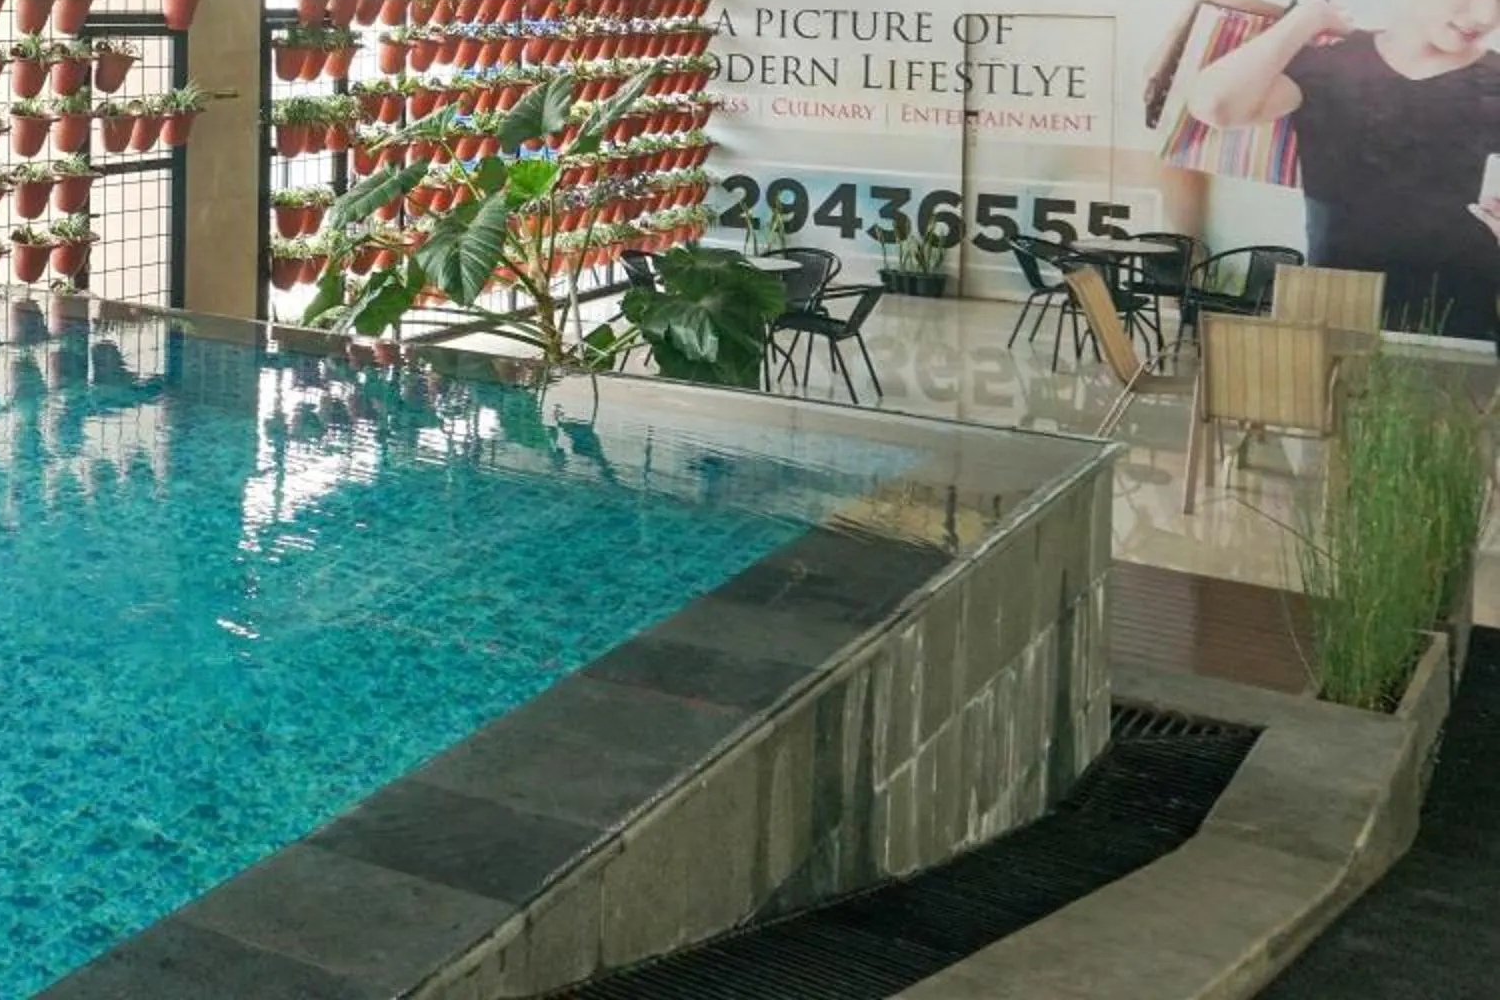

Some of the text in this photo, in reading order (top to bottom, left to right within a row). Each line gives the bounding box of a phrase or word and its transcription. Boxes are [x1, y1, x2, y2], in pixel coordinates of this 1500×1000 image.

[715, 7, 1014, 45] A PICTURE OF
[862, 53, 1087, 99] LIFESTLYE
[771, 97, 877, 121] CULINARY
[719, 174, 1131, 253] 29436555
